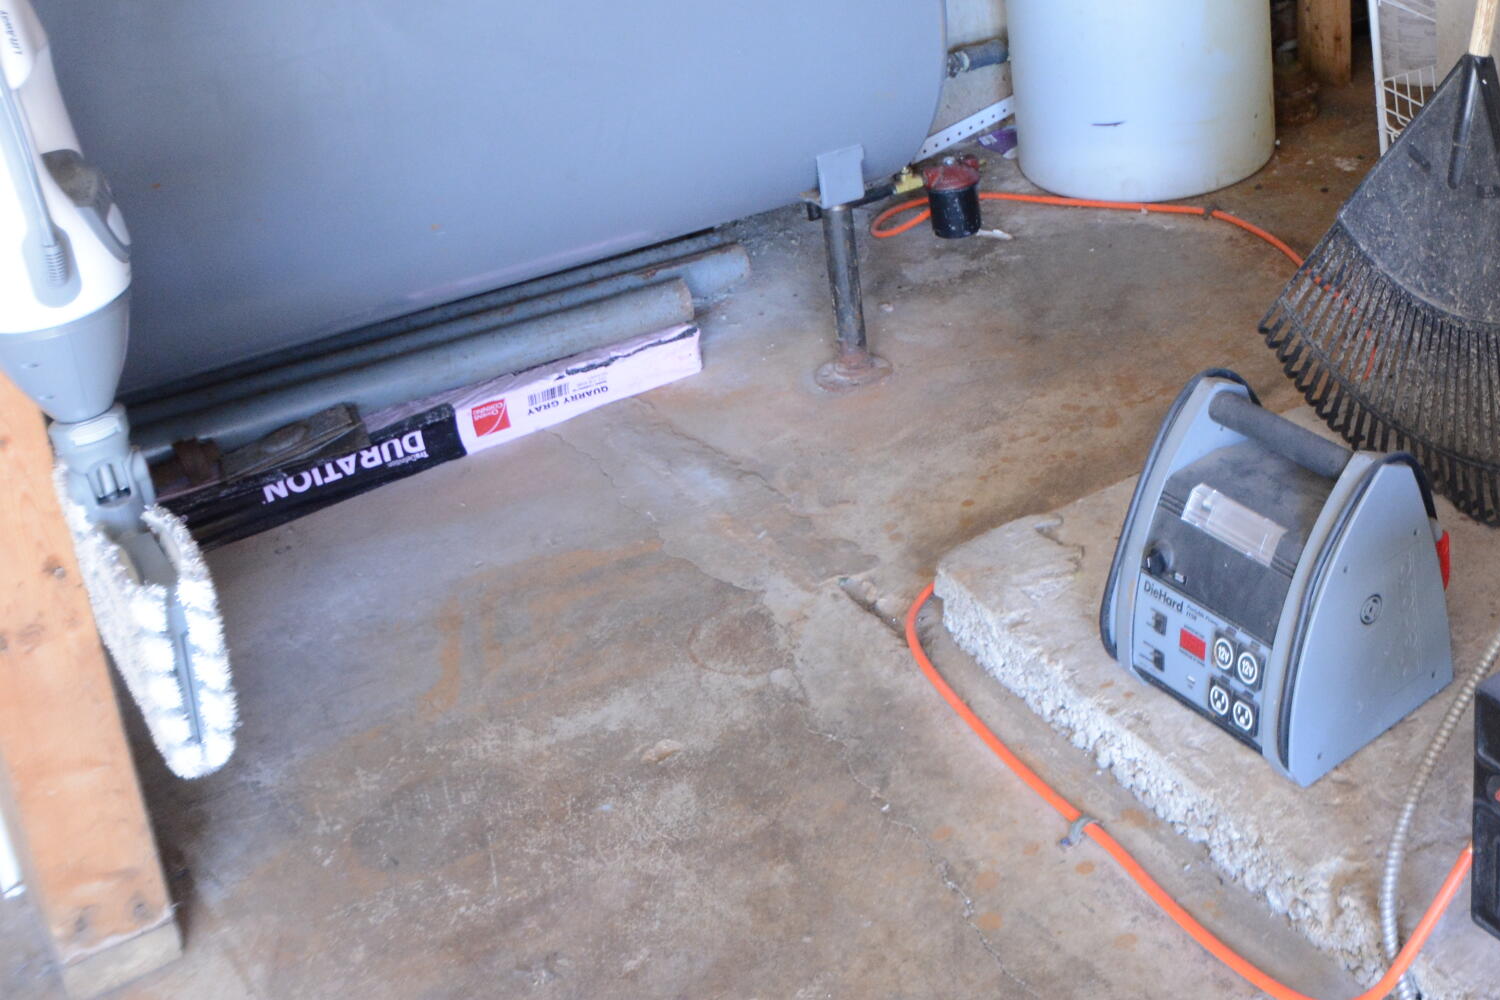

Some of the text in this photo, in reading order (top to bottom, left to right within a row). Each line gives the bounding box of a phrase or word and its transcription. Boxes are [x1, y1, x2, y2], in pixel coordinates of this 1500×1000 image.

[527, 385, 608, 416] QUARRY GRAY
[262, 430, 427, 504] DURATION
[1143, 580, 1184, 613] DieHard
[1217, 645, 1230, 663] 12V
[1241, 659, 1254, 678] 12V
